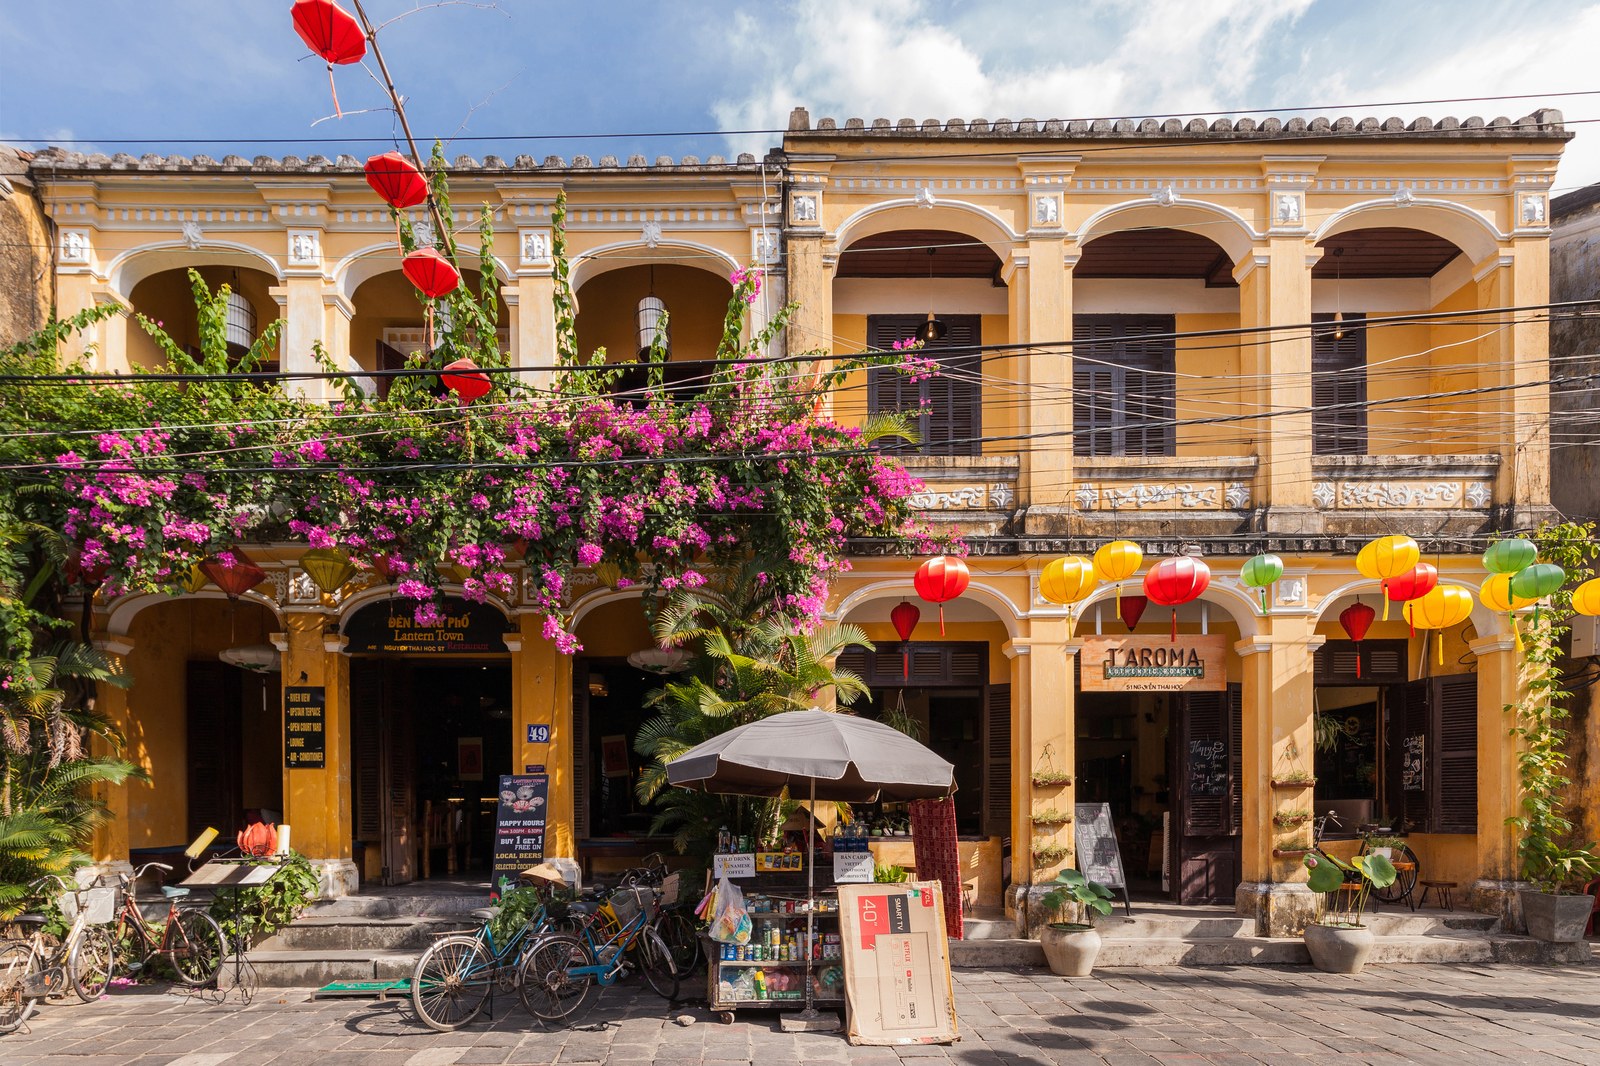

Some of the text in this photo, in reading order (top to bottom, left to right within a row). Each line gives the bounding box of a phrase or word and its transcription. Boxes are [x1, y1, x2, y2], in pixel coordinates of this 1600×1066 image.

[394, 630, 464, 641] Lantern Town
[448, 642, 489, 650] Restaurant
[290, 693, 311, 702] RIVER VIEW
[290, 722, 322, 732] OPEN COURT YARD
[529, 726, 548, 741] 49
[290, 738, 304, 747] LOUNGE
[516, 836, 520, 844] 1
[897, 921, 903, 931] TV
